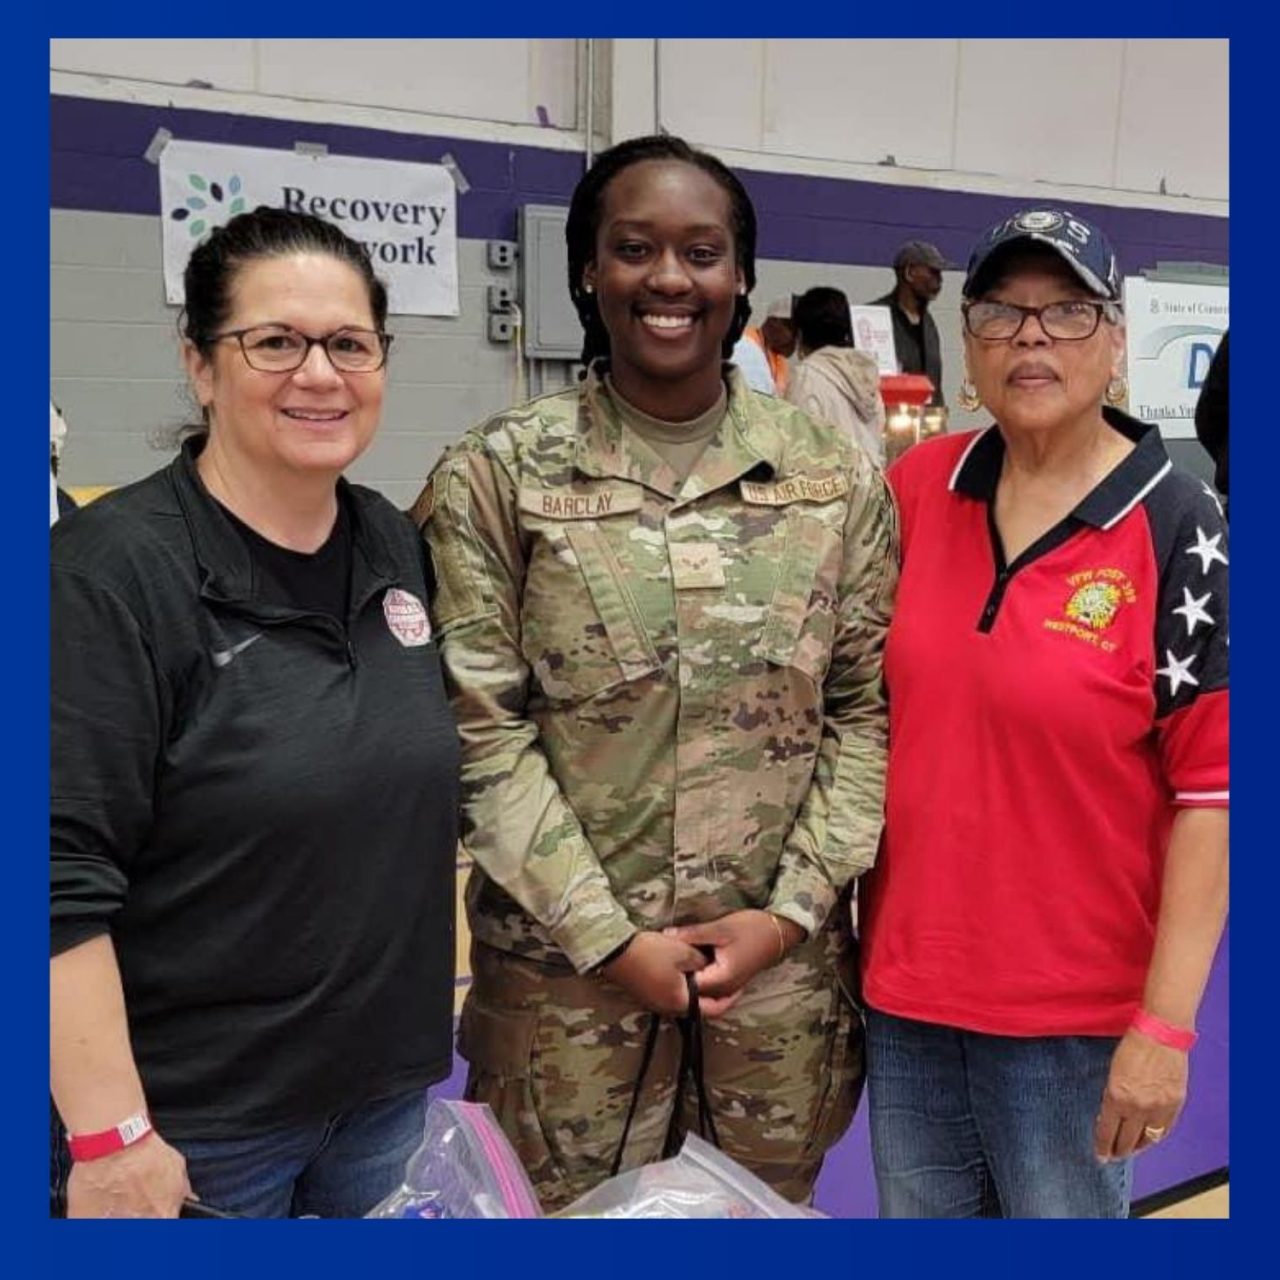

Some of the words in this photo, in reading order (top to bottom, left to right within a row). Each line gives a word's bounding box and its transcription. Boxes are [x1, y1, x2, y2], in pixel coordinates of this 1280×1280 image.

[281, 185, 447, 236] Recovery
[1187, 302, 1196, 313] of
[774, 483, 798, 501] AIR
[799, 477, 843, 497] FORCE
[542, 492, 613, 515] BARCLAY
[1065, 569, 1093, 587] VFW
[1094, 568, 1127, 580] POST
